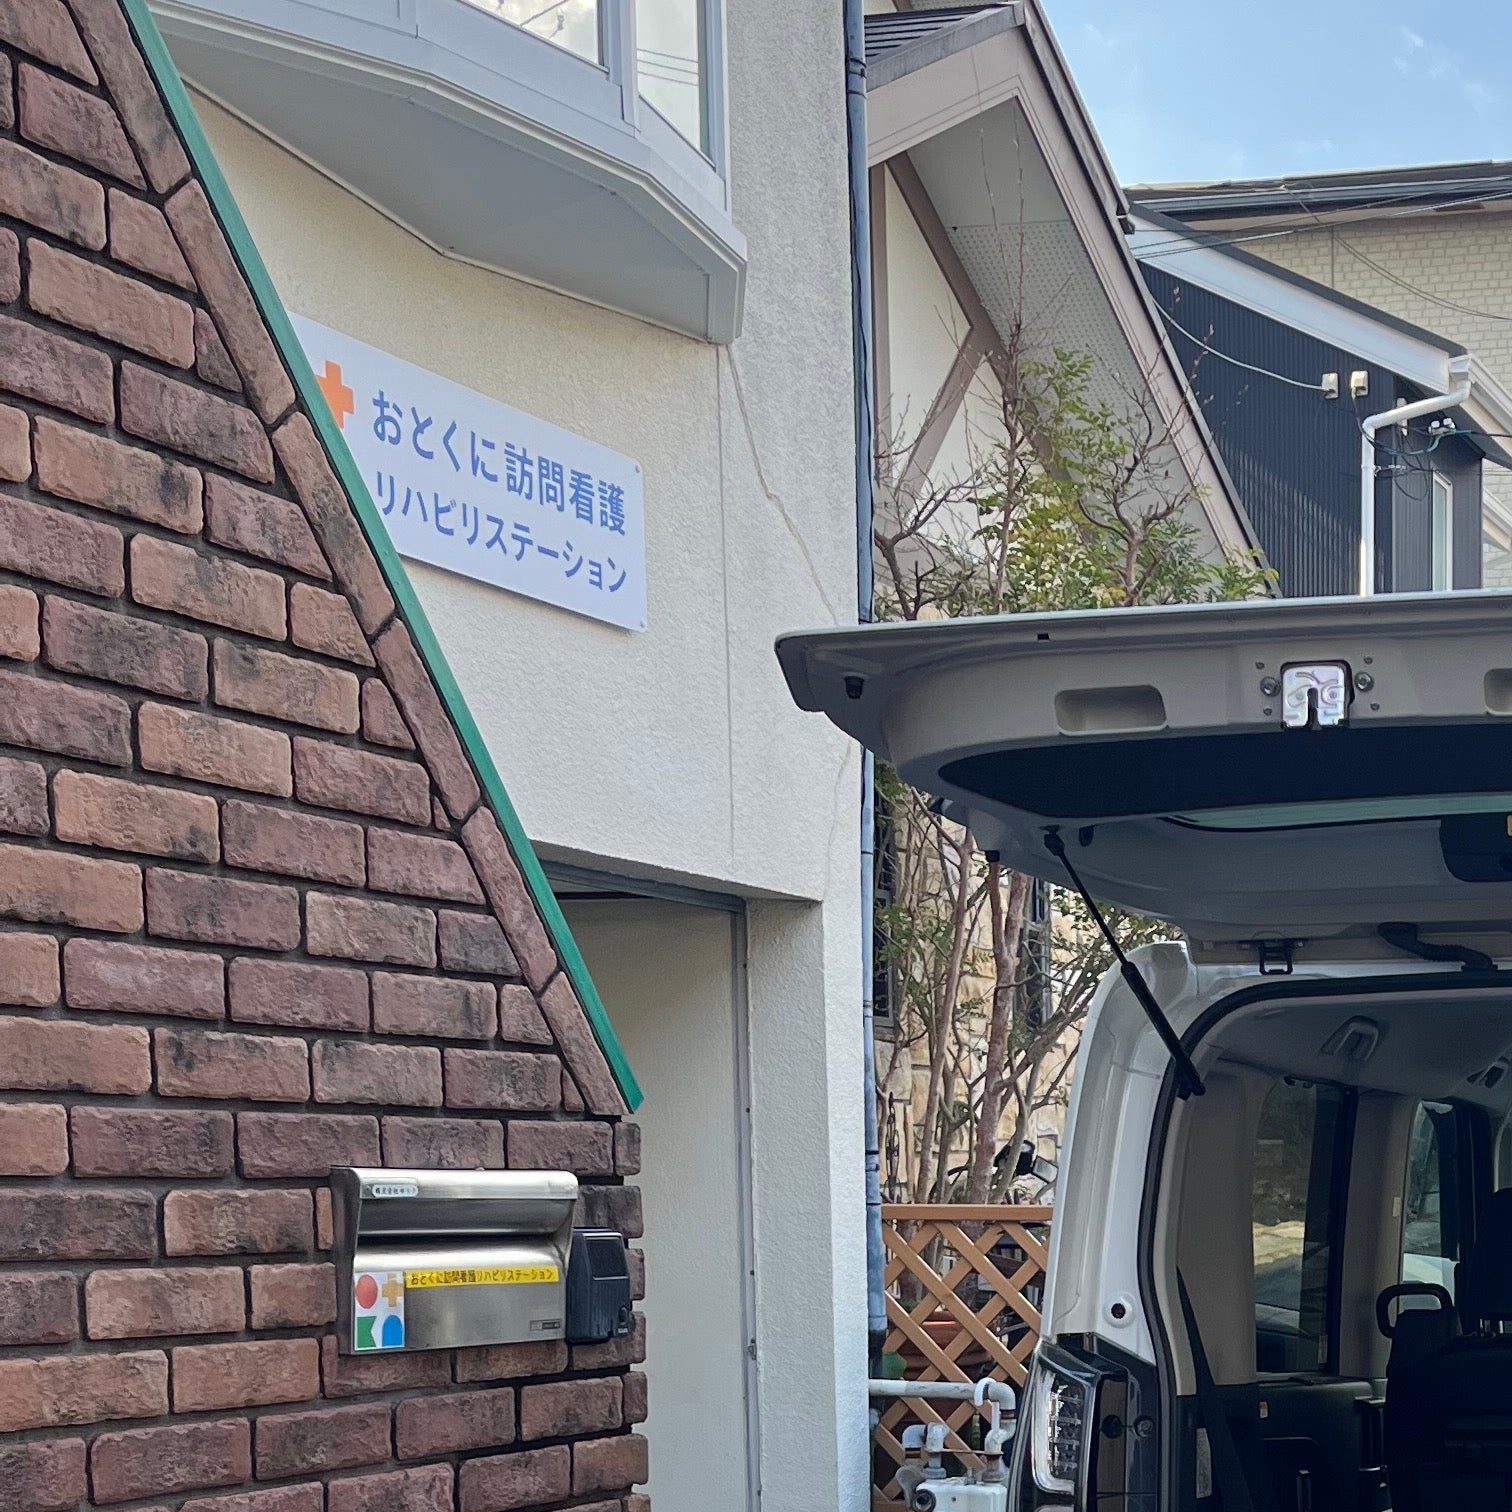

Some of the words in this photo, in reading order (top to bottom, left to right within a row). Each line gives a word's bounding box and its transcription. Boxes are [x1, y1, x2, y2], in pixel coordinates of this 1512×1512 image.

[372, 390, 626, 536] おとくに訪問看護
[376, 471, 627, 593] リハビリステーション
[411, 1269, 553, 1285] おとくに訪問看護リハビリステーション
